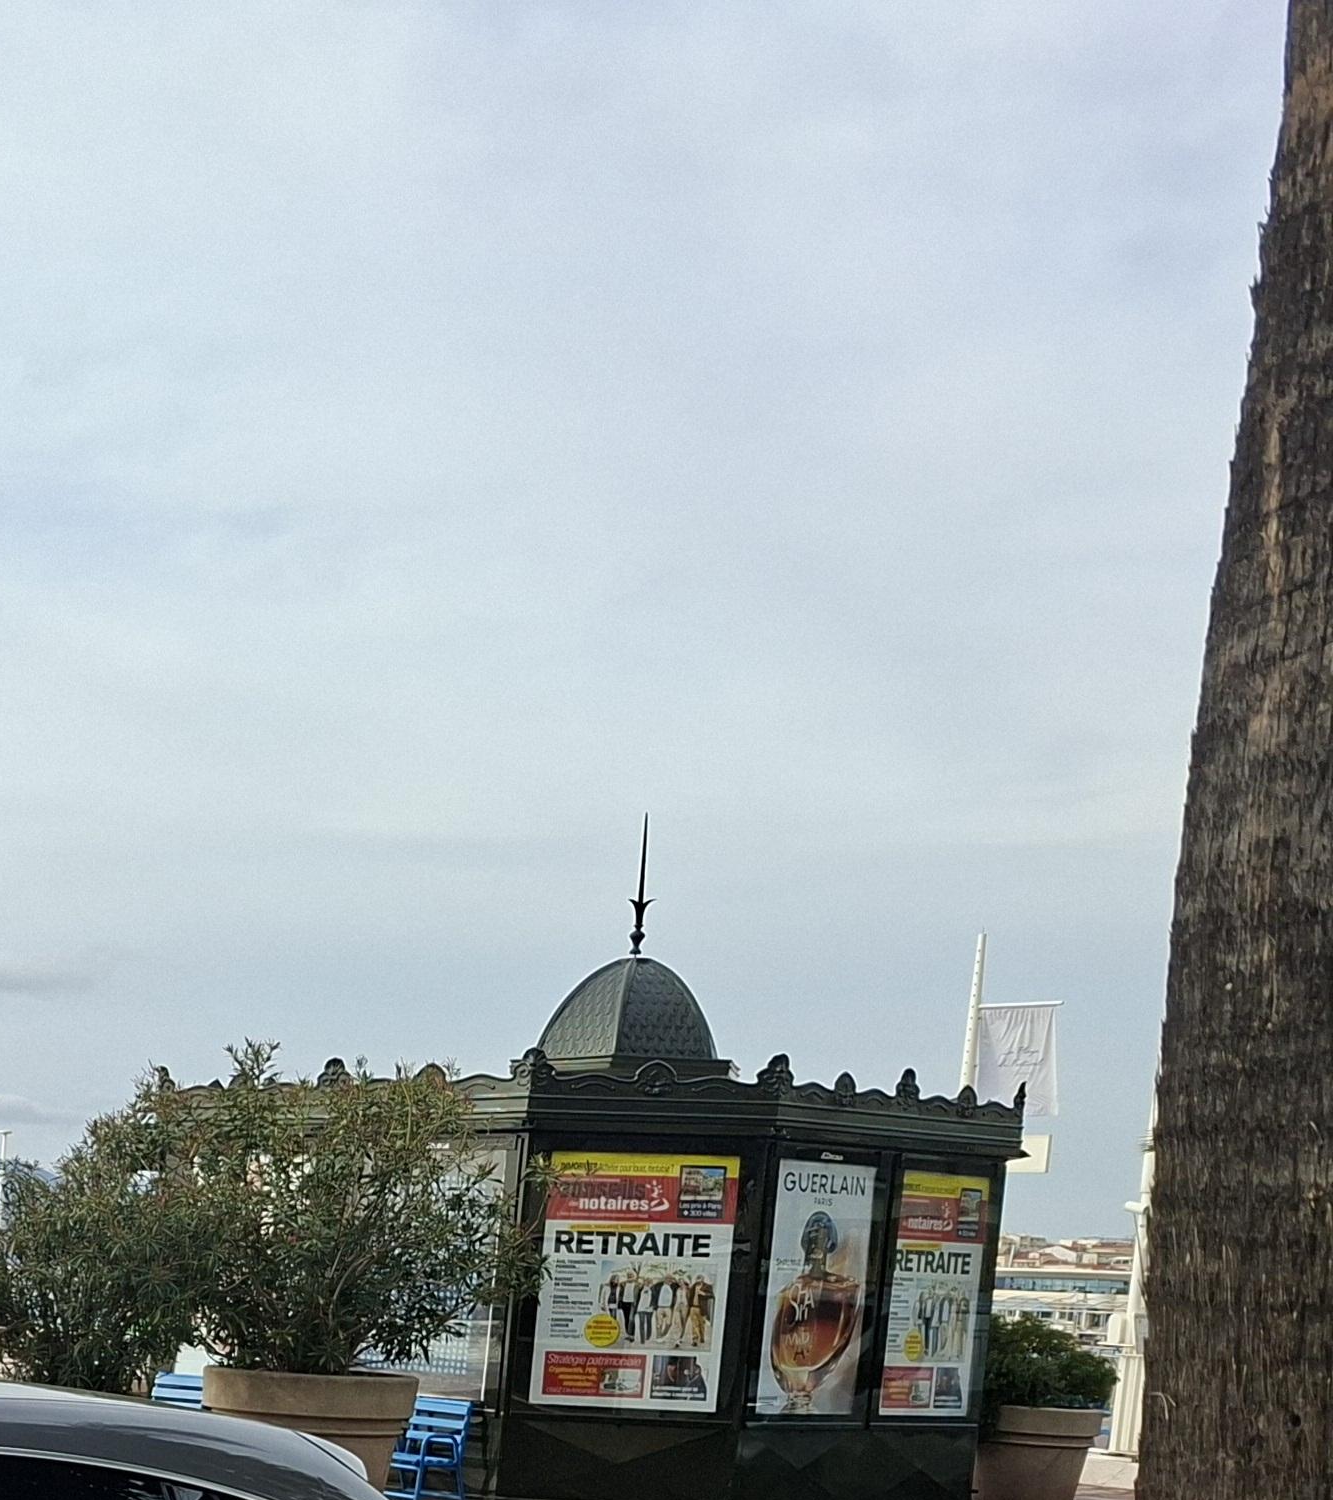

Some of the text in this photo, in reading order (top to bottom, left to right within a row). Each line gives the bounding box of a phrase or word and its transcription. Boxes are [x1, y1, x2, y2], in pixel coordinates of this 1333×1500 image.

[783, 1172, 866, 1196] GUERLAIN
[579, 1196, 649, 1211] notaires
[814, 1197, 833, 1206] PARIS
[907, 1216, 944, 1231] notaires
[554, 1230, 711, 1257] RETRAITE
[894, 1249, 972, 1274] RETRAITE
[547, 1354, 641, 1368] Stratégie patrimoniale
